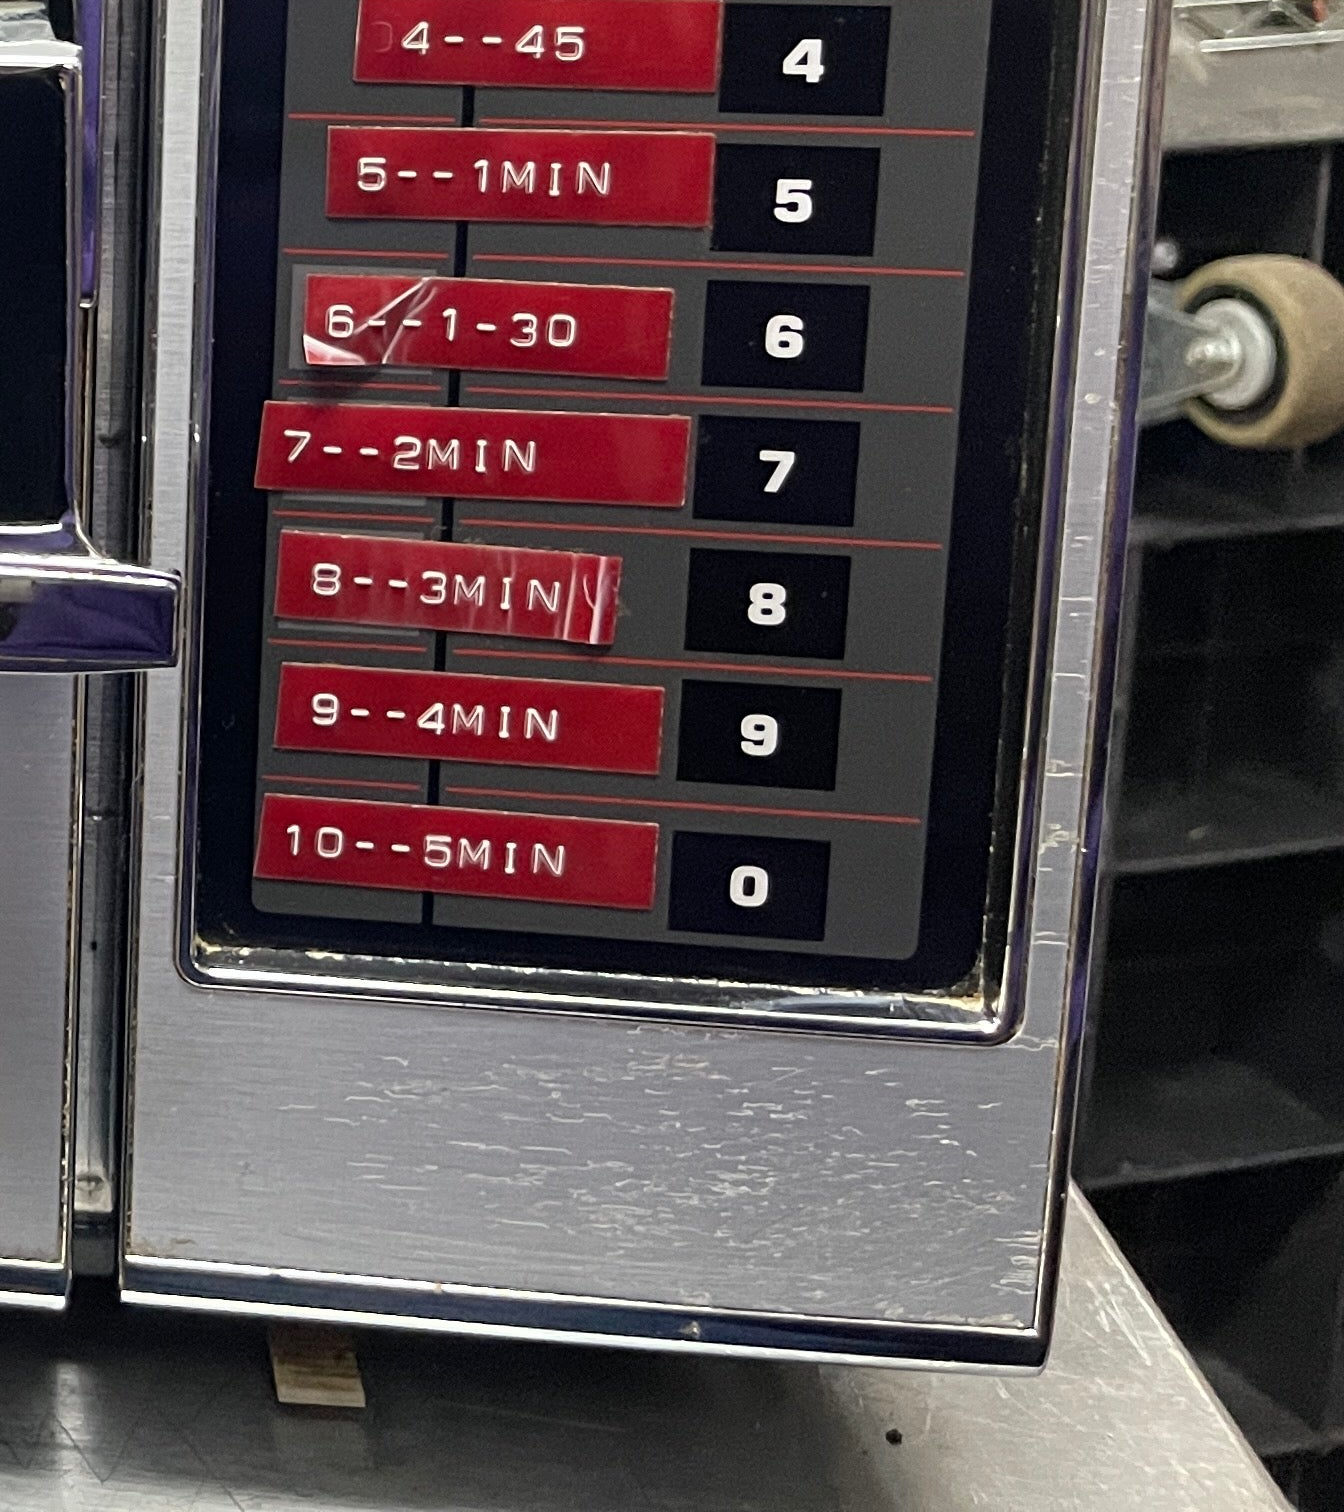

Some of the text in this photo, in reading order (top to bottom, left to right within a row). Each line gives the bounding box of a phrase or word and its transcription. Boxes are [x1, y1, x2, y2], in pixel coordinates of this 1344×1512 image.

[783, 39, 824, 82] 4
[774, 179, 812, 222] 5
[766, 315, 803, 358] 6
[760, 450, 795, 492] 7
[748, 583, 786, 625] 8
[741, 715, 777, 755] 9
[730, 866, 768, 906] 0
